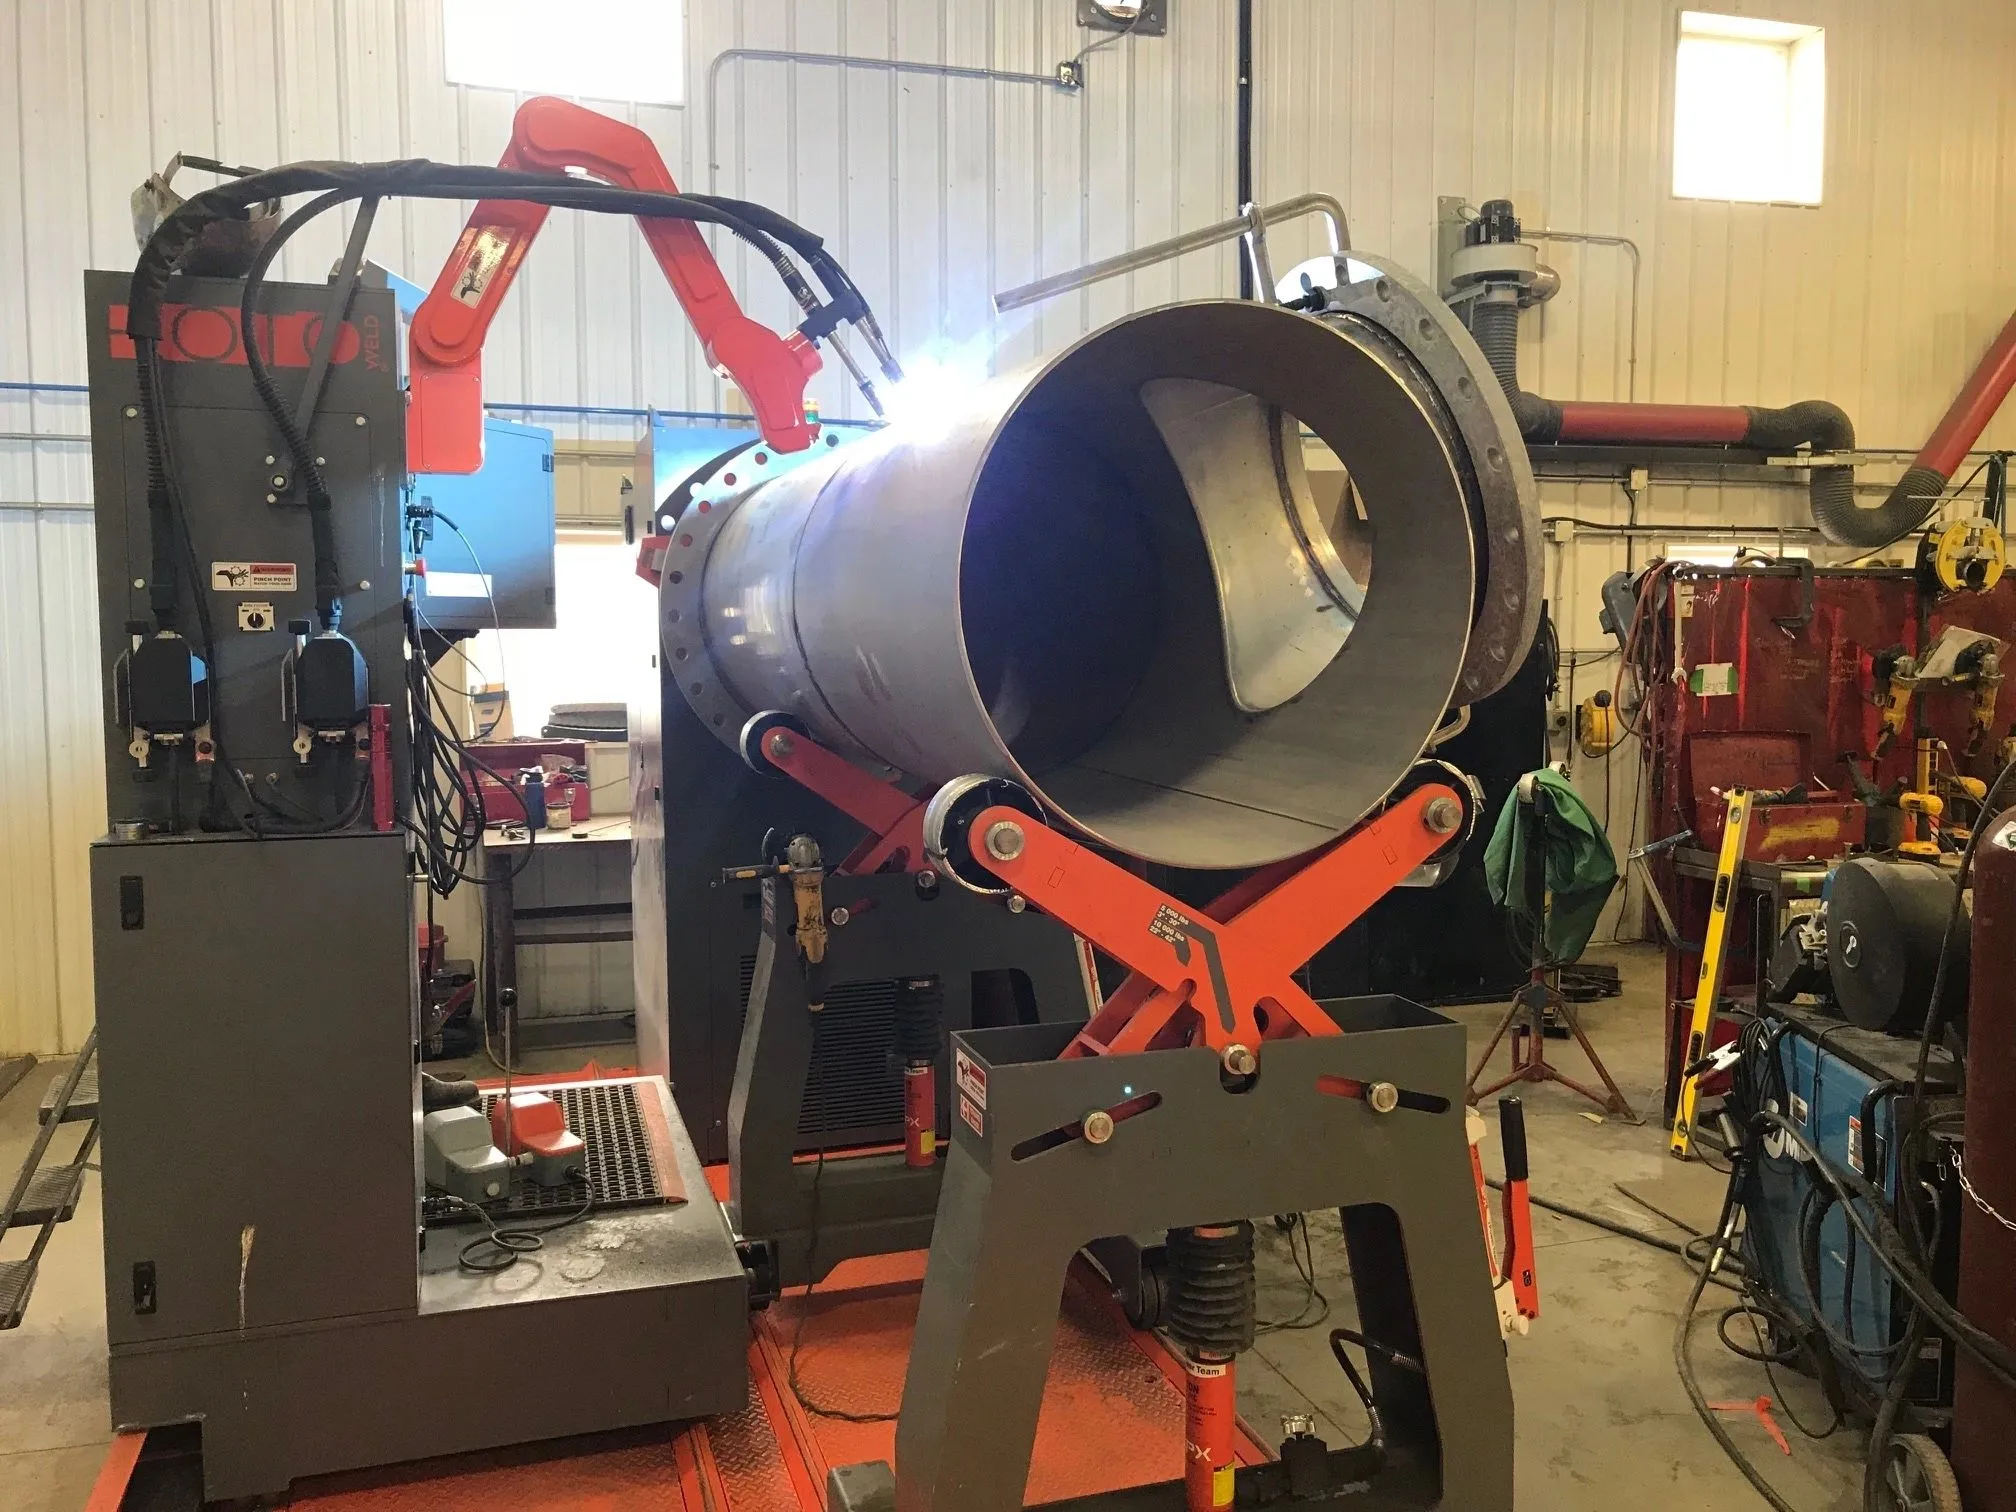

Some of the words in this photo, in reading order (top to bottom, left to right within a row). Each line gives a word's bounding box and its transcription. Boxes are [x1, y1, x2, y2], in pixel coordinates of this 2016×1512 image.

[364, 314, 382, 370] WELD
[1178, 915, 1189, 925] lbs
[1175, 932, 1185, 942] lbs
[1196, 1366, 1220, 1376] Team
